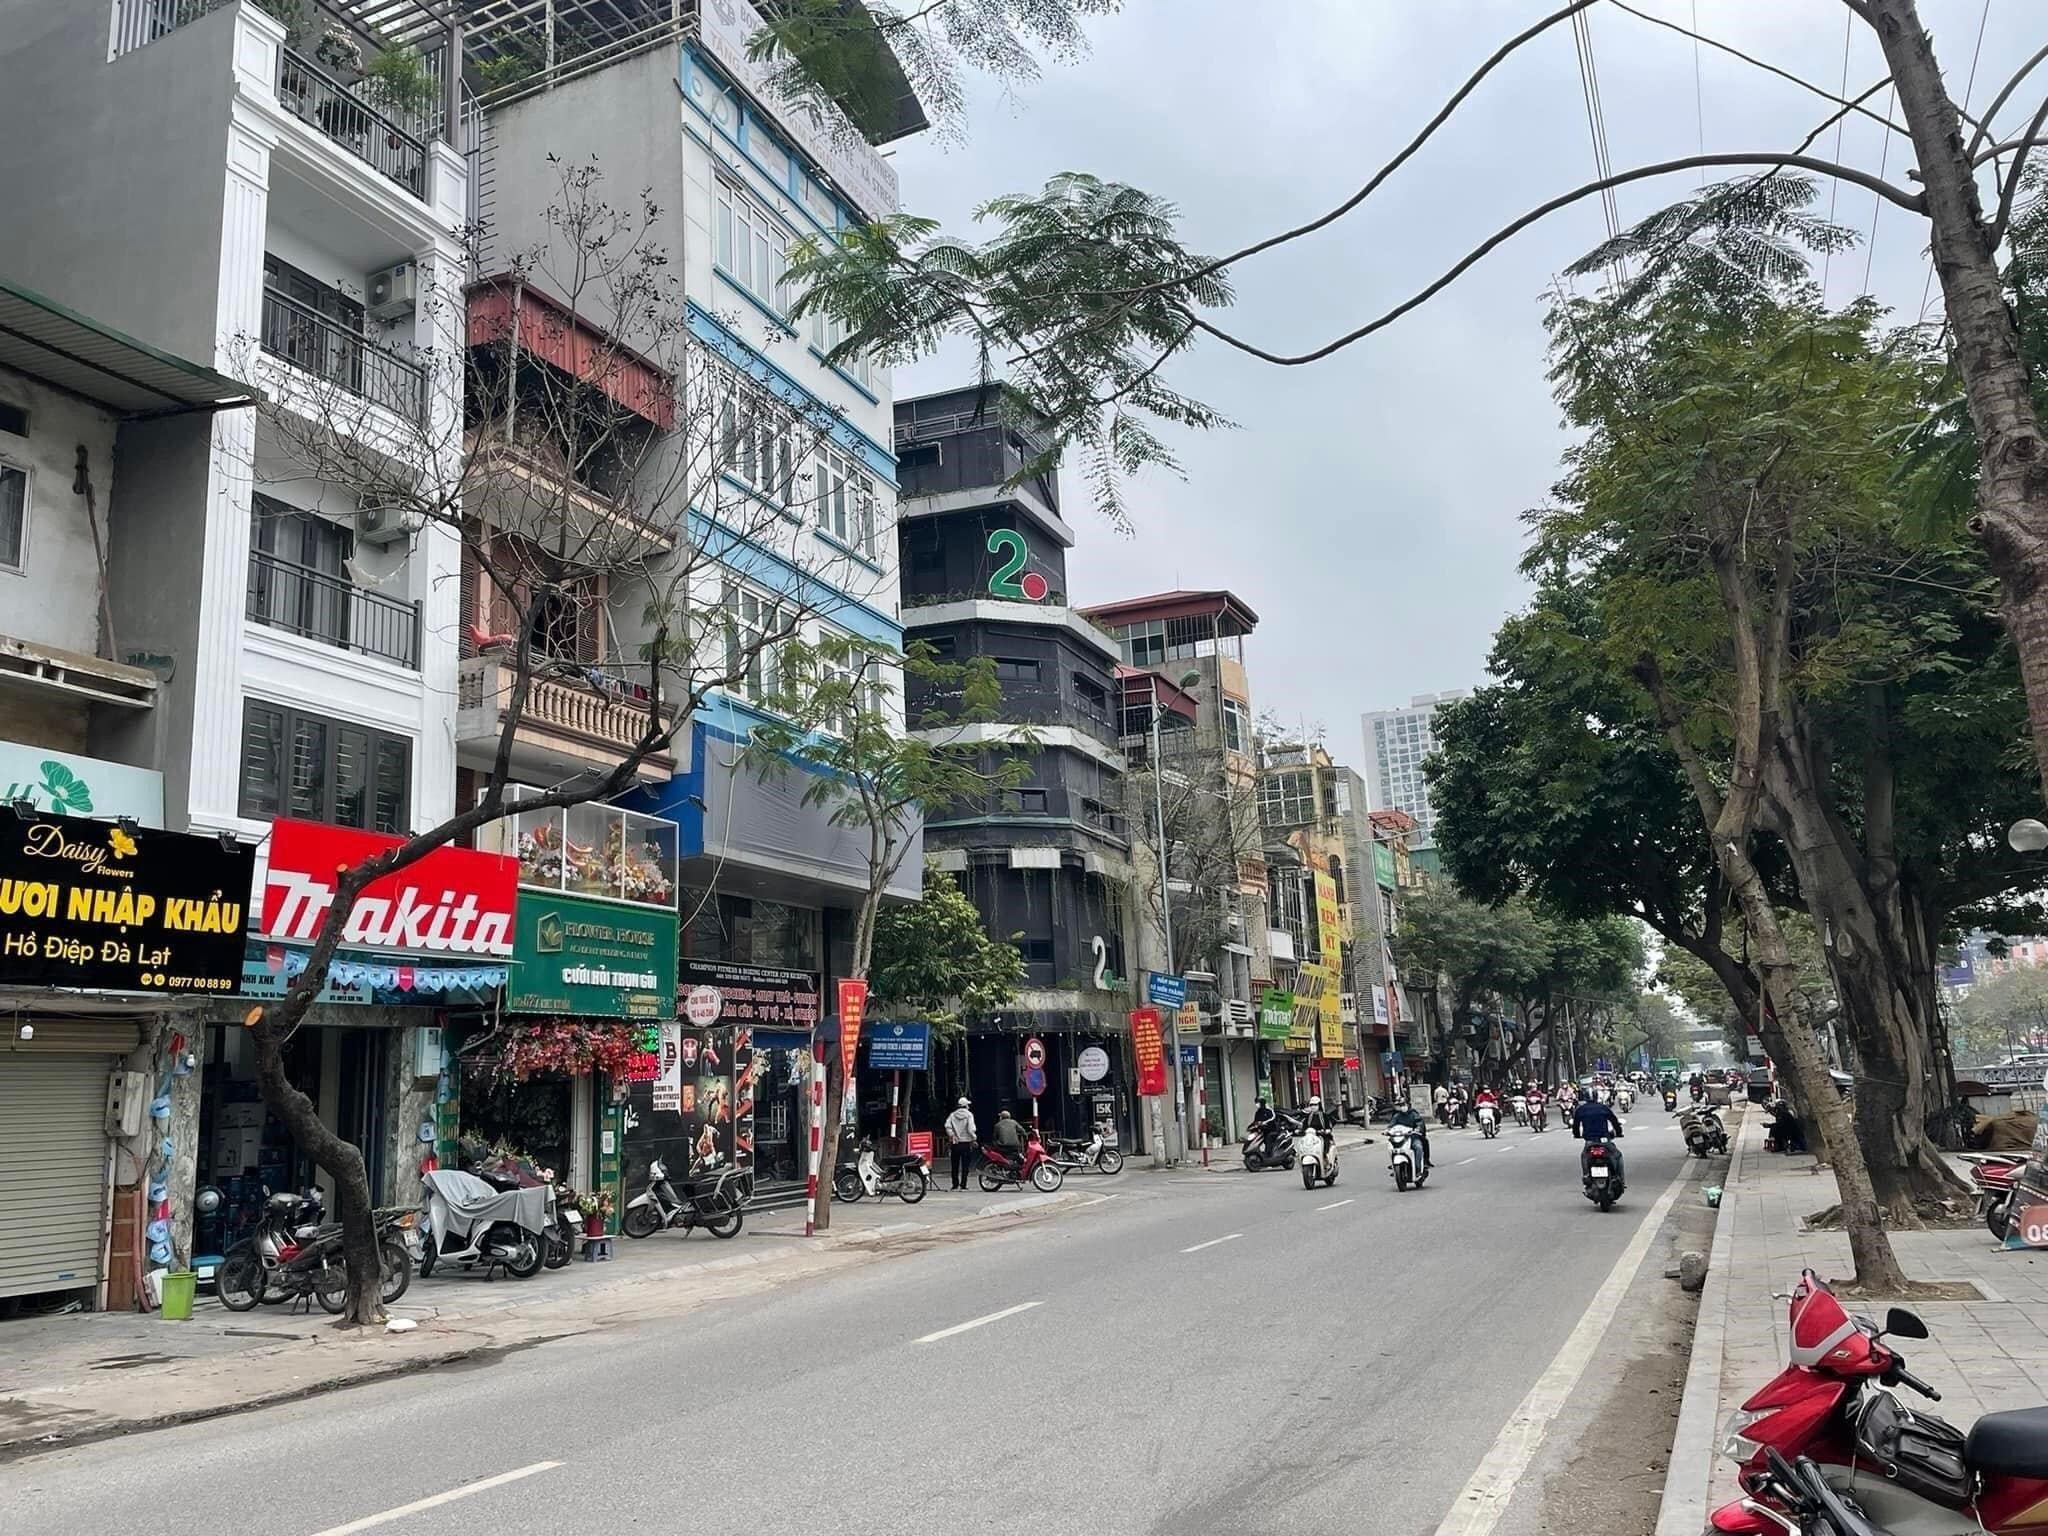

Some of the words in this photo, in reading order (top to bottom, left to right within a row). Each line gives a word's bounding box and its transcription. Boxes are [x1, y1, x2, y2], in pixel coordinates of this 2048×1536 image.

[23, 824, 109, 873] Daisy
[97, 864, 134, 879] Flowers
[0, 878, 60, 918] ƯƠI
[67, 885, 156, 934] NHẬP
[163, 889, 241, 934] KHẨU
[4, 931, 38, 957] Hồ
[44, 935, 94, 966] Điệp
[101, 940, 131, 963] Đà
[138, 943, 172, 969] Lạt
[168, 976, 193, 988] 0977
[193, 977, 206, 989] 00
[206, 978, 219, 989] 88
[219, 978, 232, 989] 99
